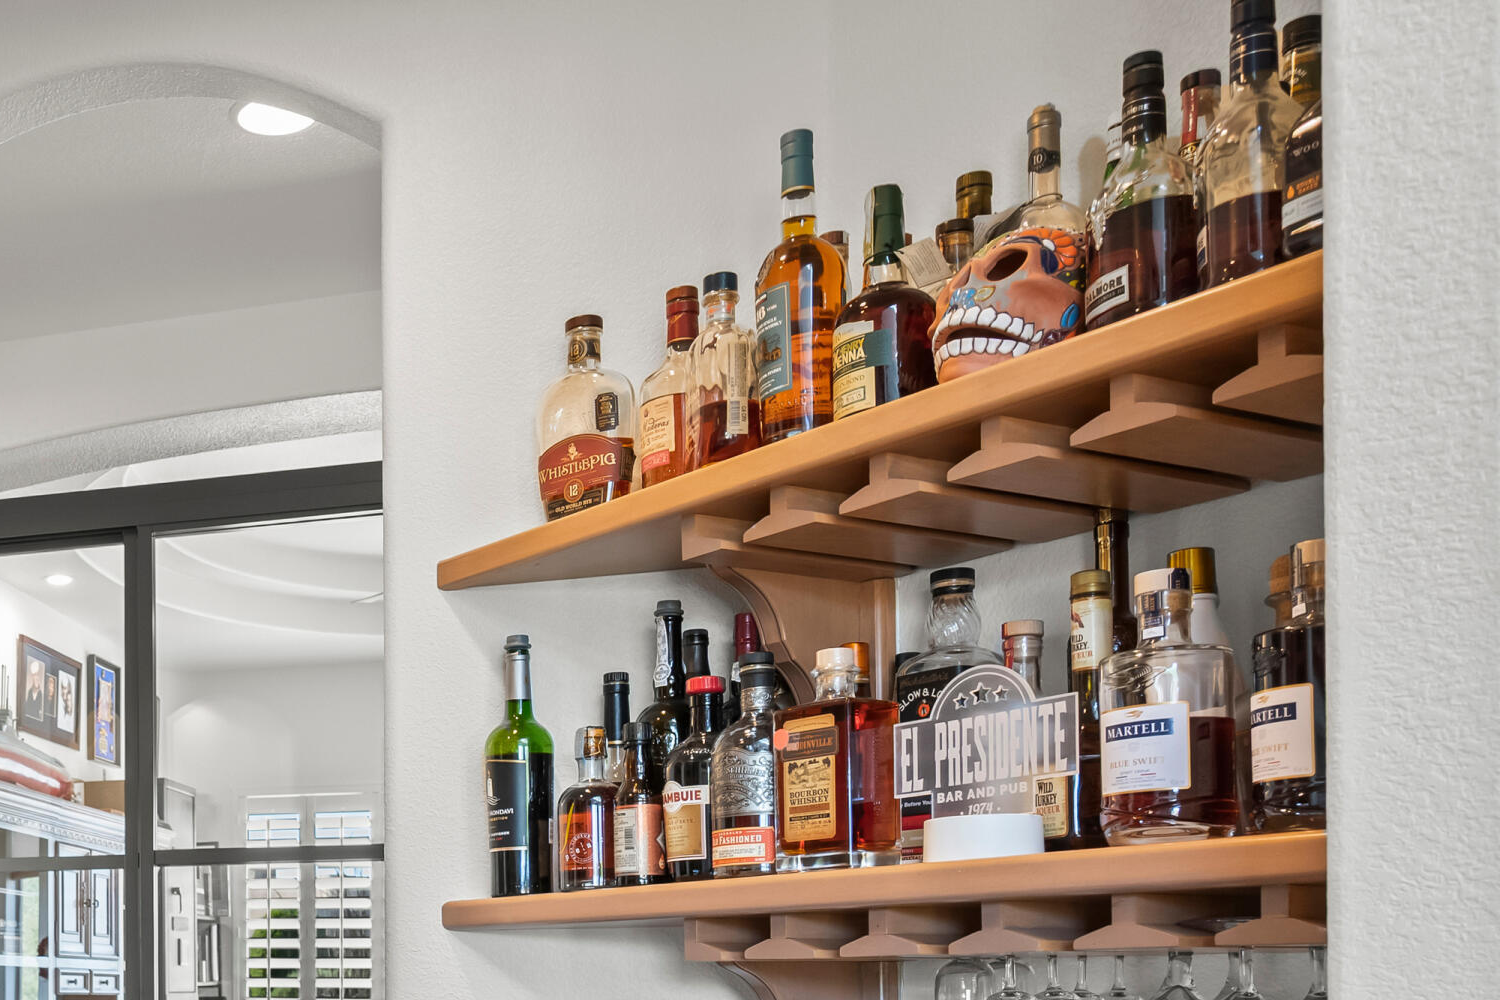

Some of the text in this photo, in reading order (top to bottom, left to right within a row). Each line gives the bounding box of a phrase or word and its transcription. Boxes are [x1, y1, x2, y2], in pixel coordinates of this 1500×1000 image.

[538, 452, 617, 485] WHISTLEPIG
[569, 484, 579, 497] 12
[898, 688, 921, 712] SLOW
[931, 688, 944, 699] LO
[1107, 721, 1169, 740] MARTELL
[901, 701, 1068, 793] EL PRESIDENTE
[789, 788, 830, 799] BOURBON
[936, 781, 1028, 804] BAR AND PUB
[1037, 782, 1054, 794] WILD
[789, 795, 829, 806] WHISKEY
[967, 801, 993, 816] 1974
[719, 834, 762, 845] FASHIONED
